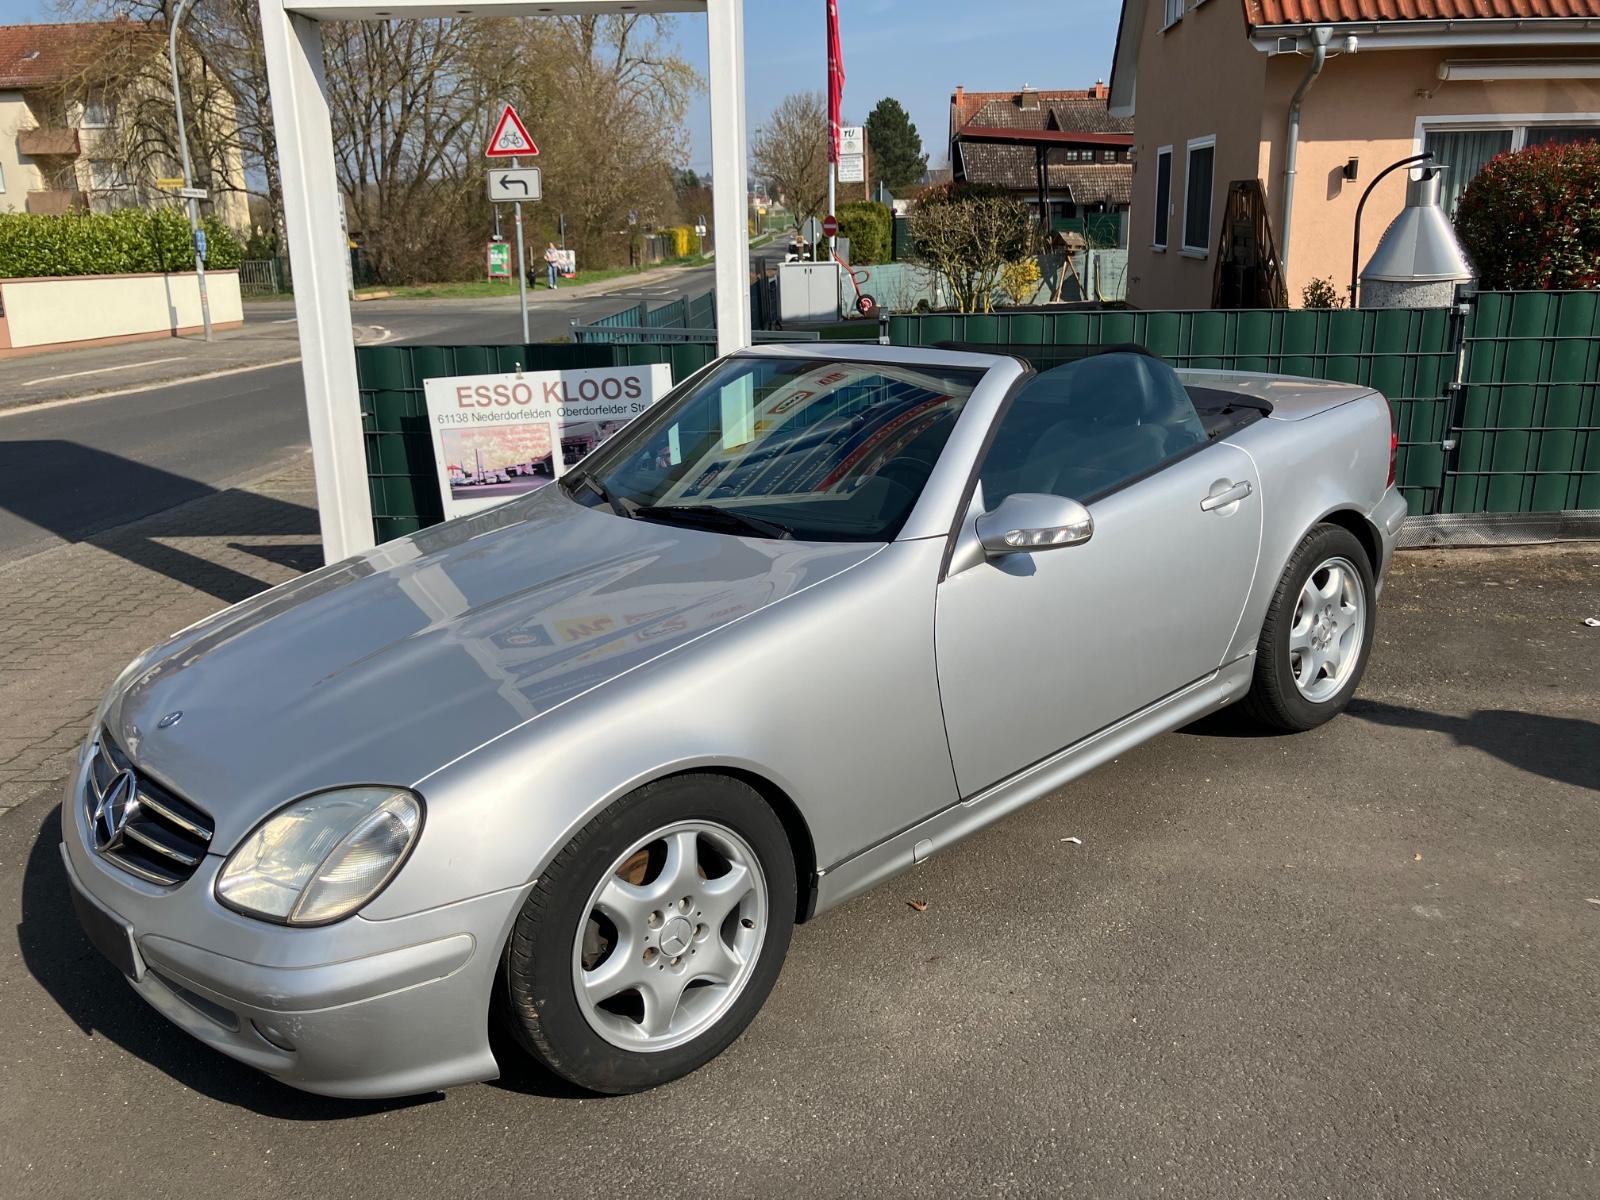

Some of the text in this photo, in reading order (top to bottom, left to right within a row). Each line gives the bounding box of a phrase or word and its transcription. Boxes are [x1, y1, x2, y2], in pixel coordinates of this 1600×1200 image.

[456, 376, 642, 408] ESSO KLOOS
[438, 413, 468, 424] 61138
[471, 408, 551, 422] Niederdorfelden
[557, 404, 627, 417] Oberdorfelder
